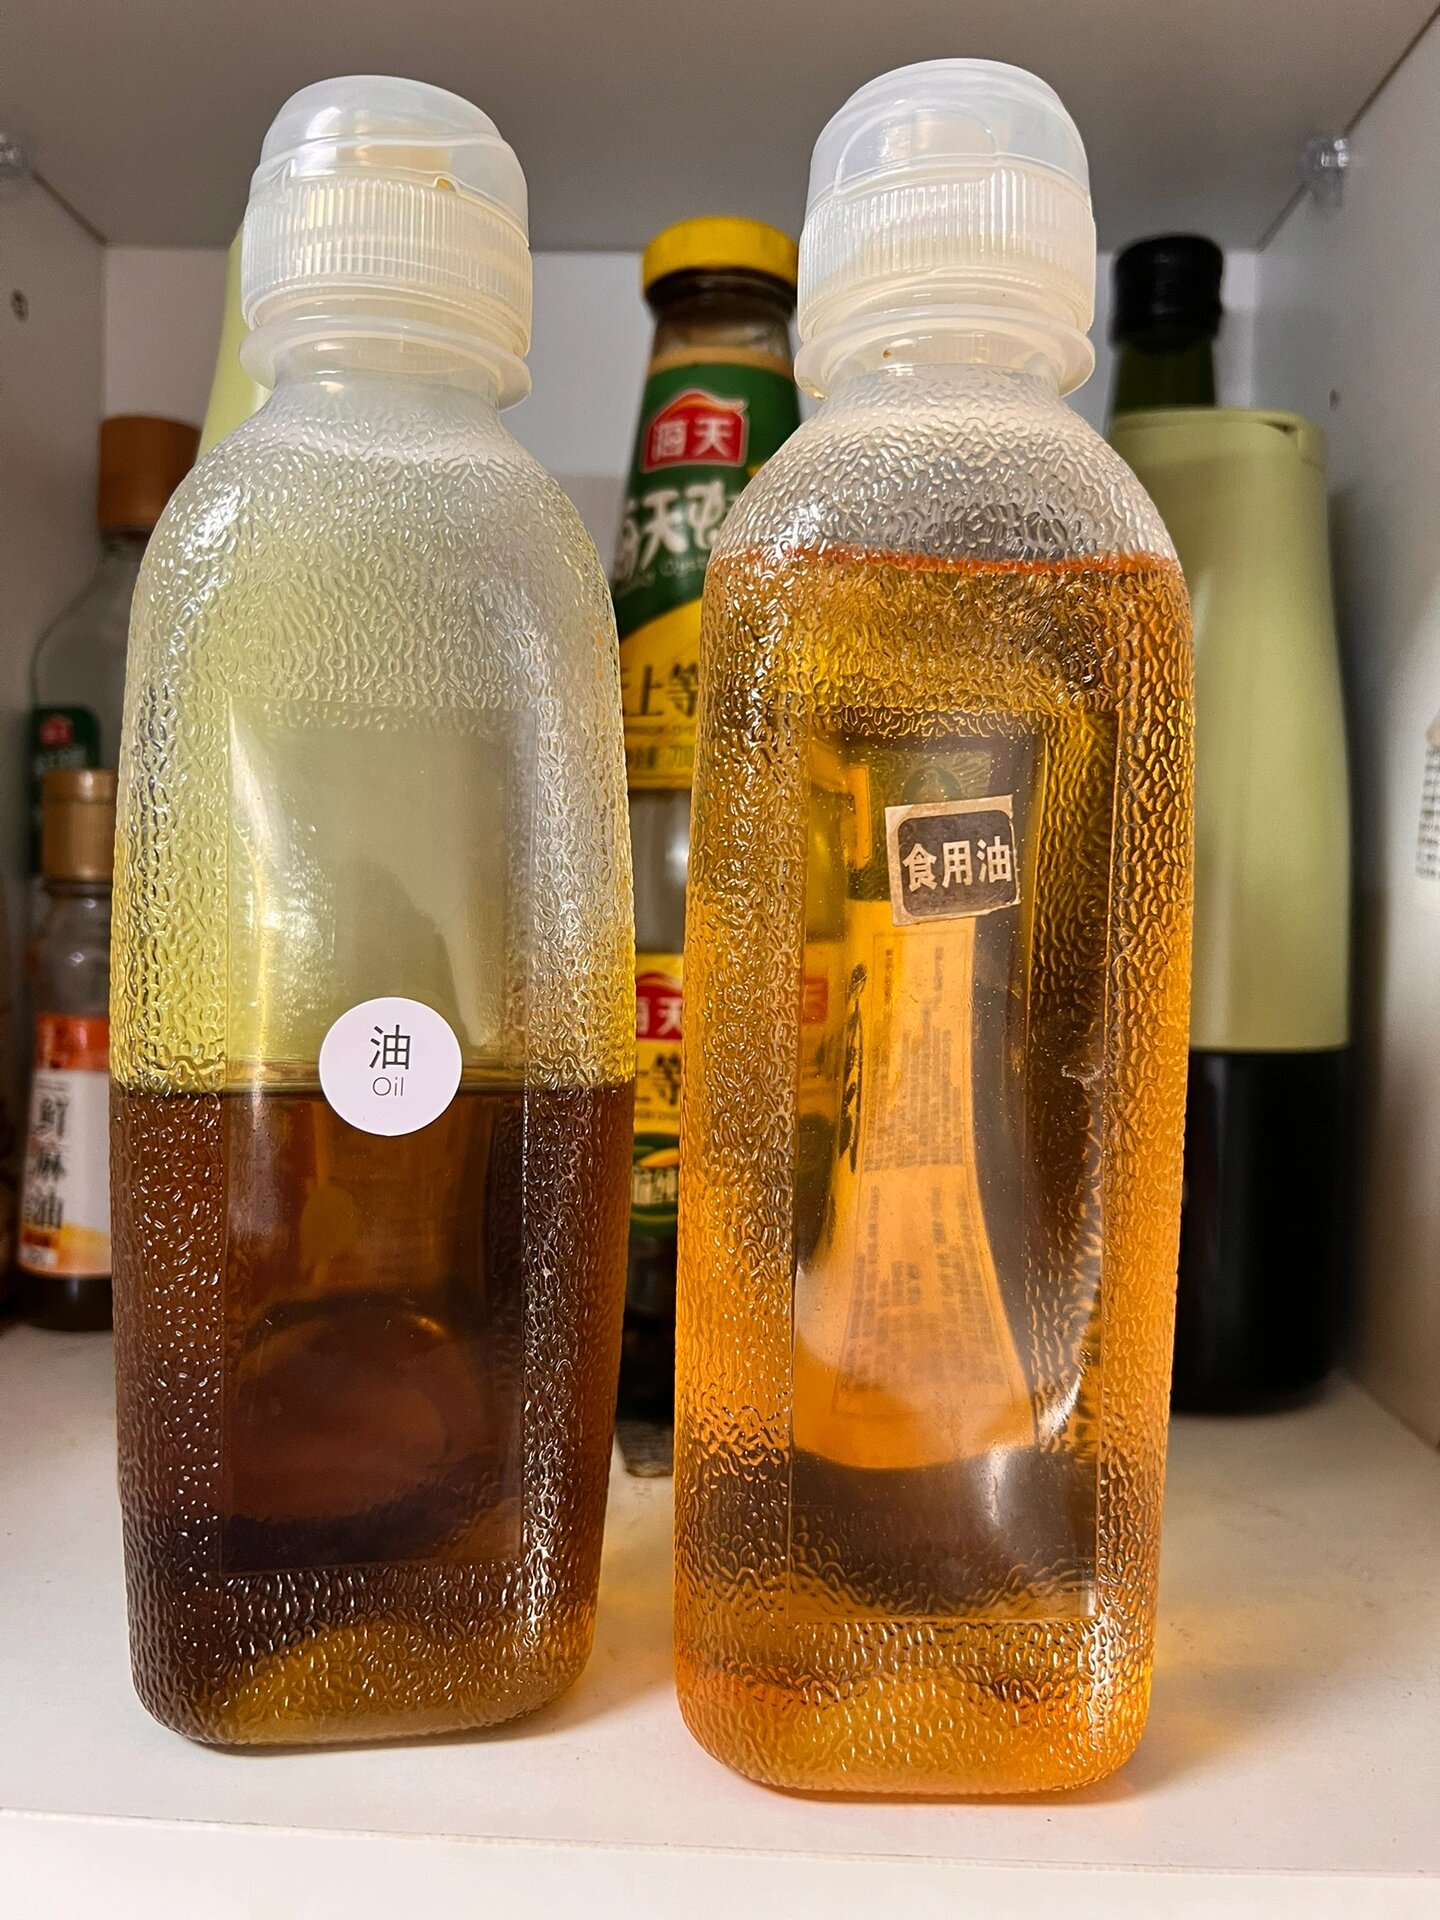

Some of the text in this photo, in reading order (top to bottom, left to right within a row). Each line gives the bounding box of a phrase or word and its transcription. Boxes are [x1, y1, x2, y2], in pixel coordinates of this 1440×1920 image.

[652, 416, 736, 462] 海天
[902, 835, 1012, 892] 食用油
[369, 1024, 411, 1070] 油
[372, 1077, 404, 1097] Oil
